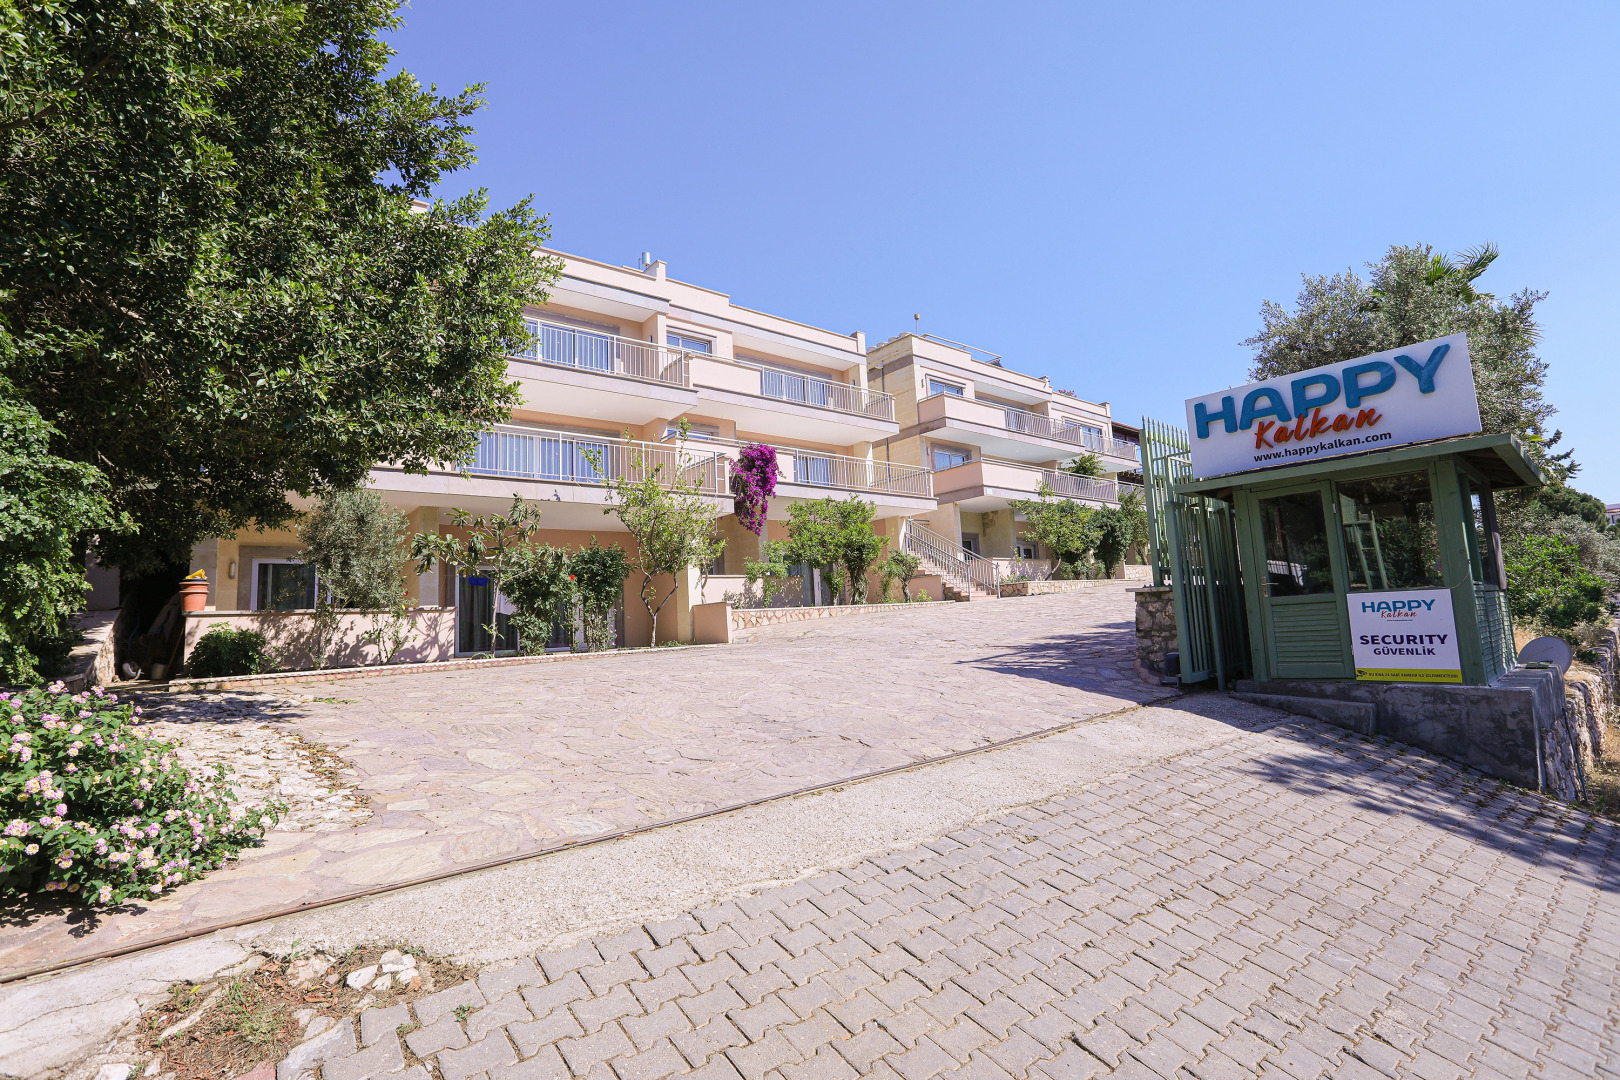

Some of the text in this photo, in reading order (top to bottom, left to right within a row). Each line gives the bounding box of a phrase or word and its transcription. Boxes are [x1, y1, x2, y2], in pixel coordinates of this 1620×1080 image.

[1194, 343, 1451, 439] HAPPY
[1254, 407, 1382, 449] Kalkan
[1253, 430, 1392, 462] www.happykalkan.com
[1362, 599, 1436, 612] HAPPY
[1380, 610, 1418, 618] Kalkan
[1360, 634, 1448, 645] SECURITY
[1373, 646, 1436, 656] GÜVENLİK
